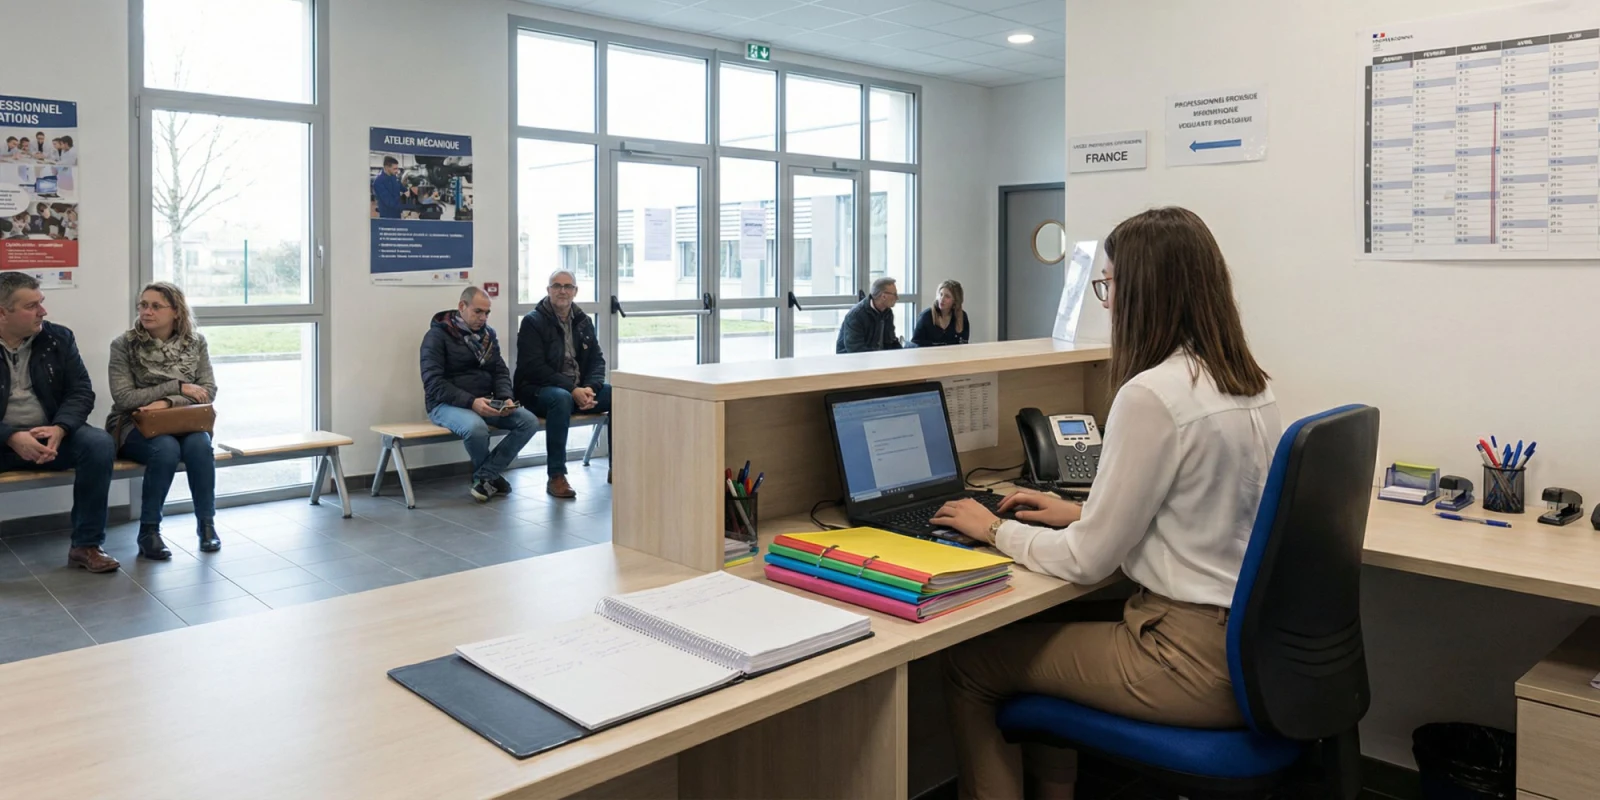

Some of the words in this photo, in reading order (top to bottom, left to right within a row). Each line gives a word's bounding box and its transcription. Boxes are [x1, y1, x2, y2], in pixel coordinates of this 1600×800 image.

[384, 135, 415, 146] ATELIER
[417, 137, 460, 150] MÉCANIQUE
[1086, 150, 1128, 164] FRANCE
